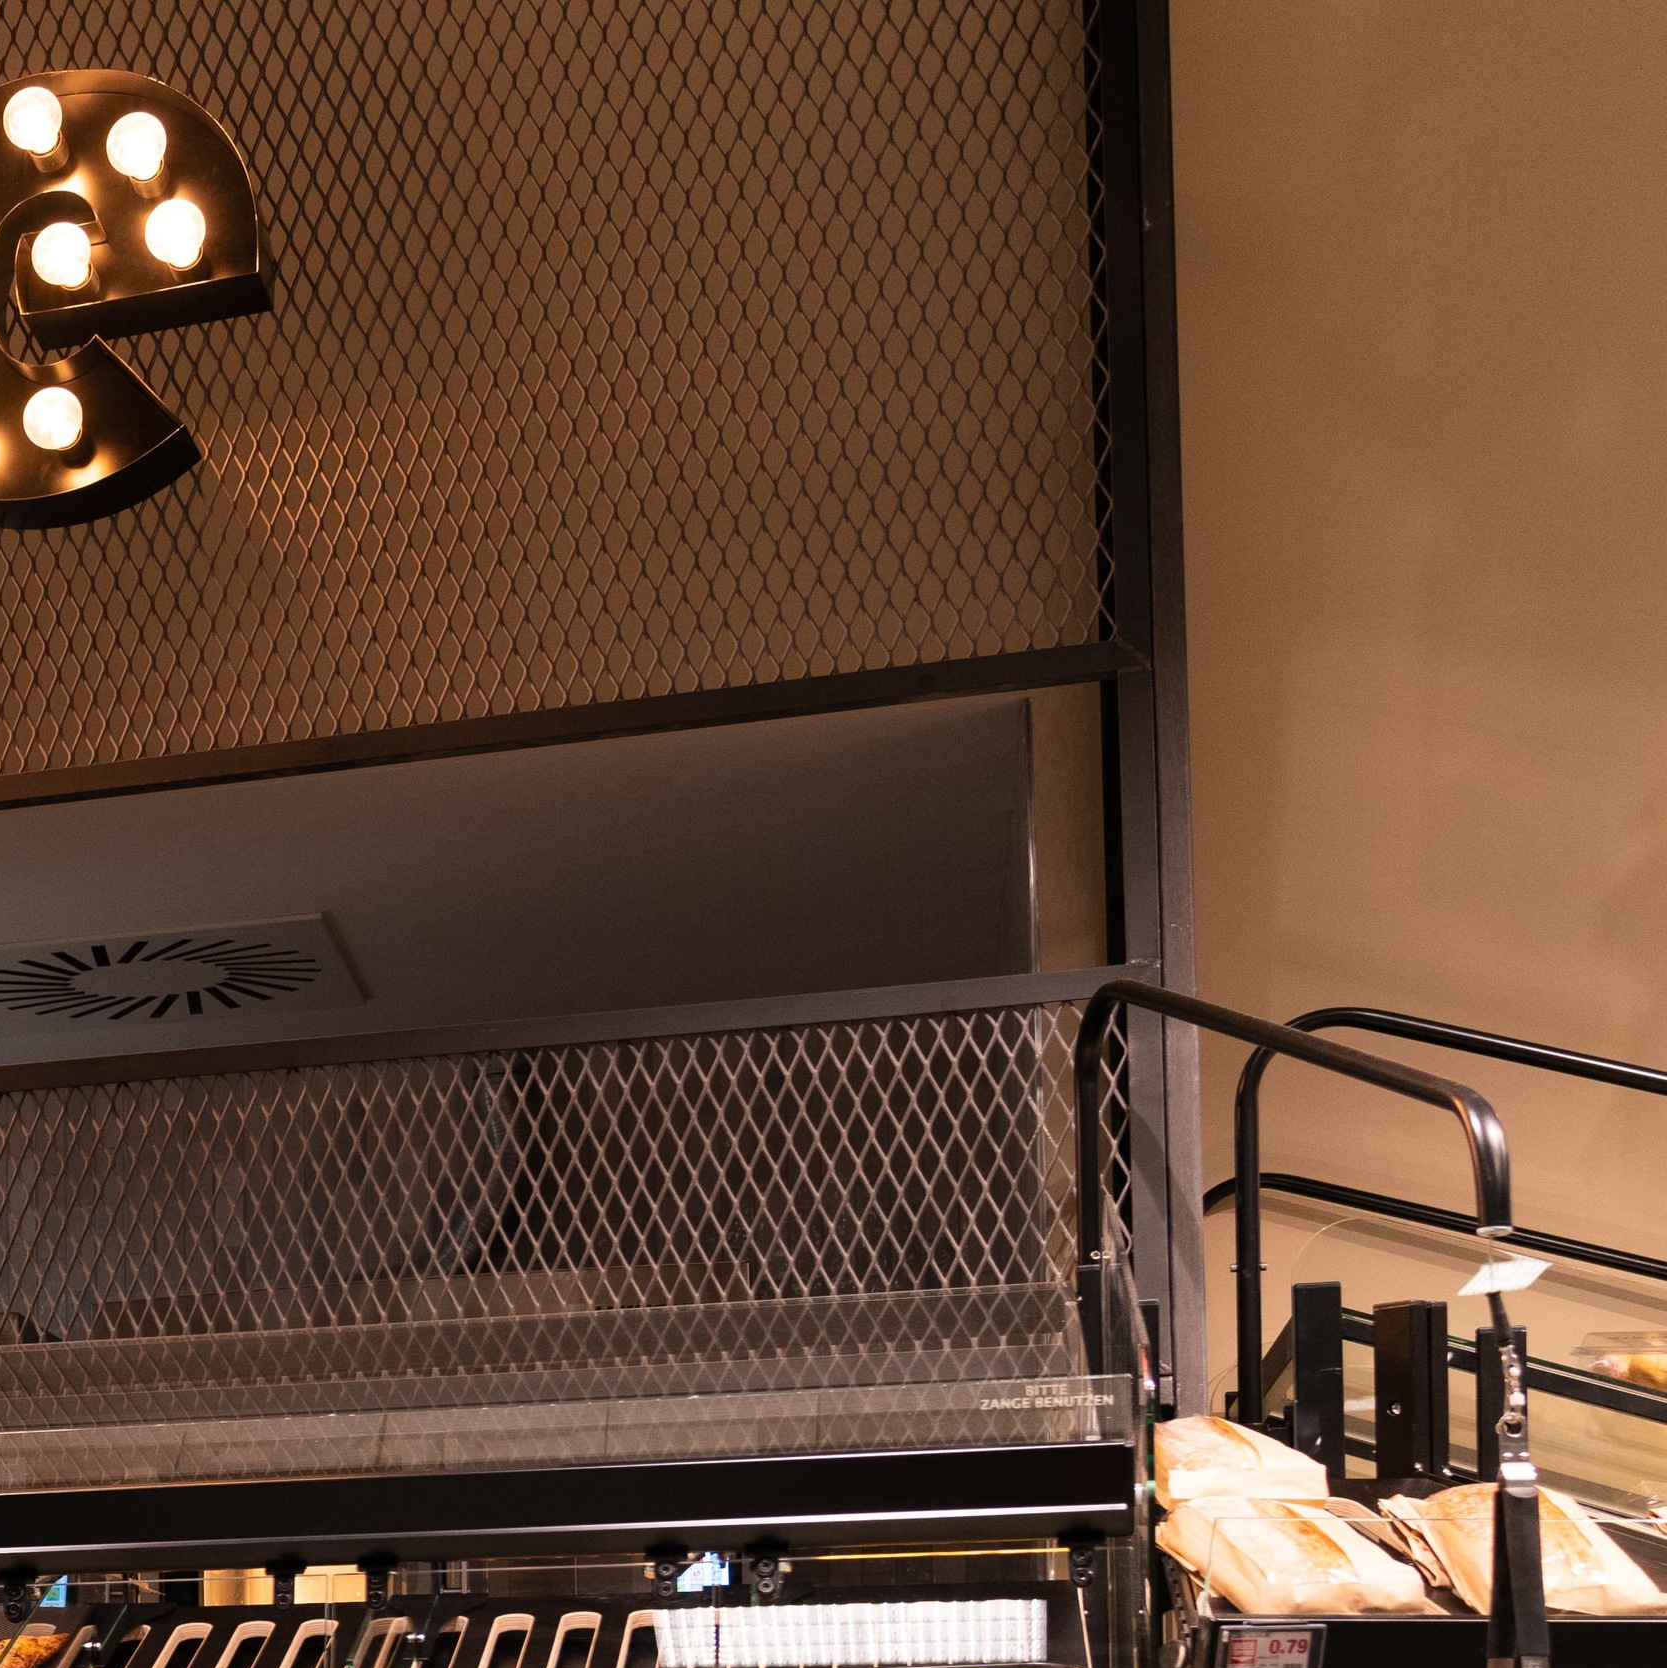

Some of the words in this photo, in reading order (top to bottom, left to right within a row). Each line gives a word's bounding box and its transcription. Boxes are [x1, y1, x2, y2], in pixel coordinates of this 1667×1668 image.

[1026, 1384, 1068, 1397] BITTE
[980, 1399, 1030, 1411] ZANGE
[1034, 1394, 1115, 1409] BENUTZEN
[1268, 1639, 1308, 1655] 0.79
